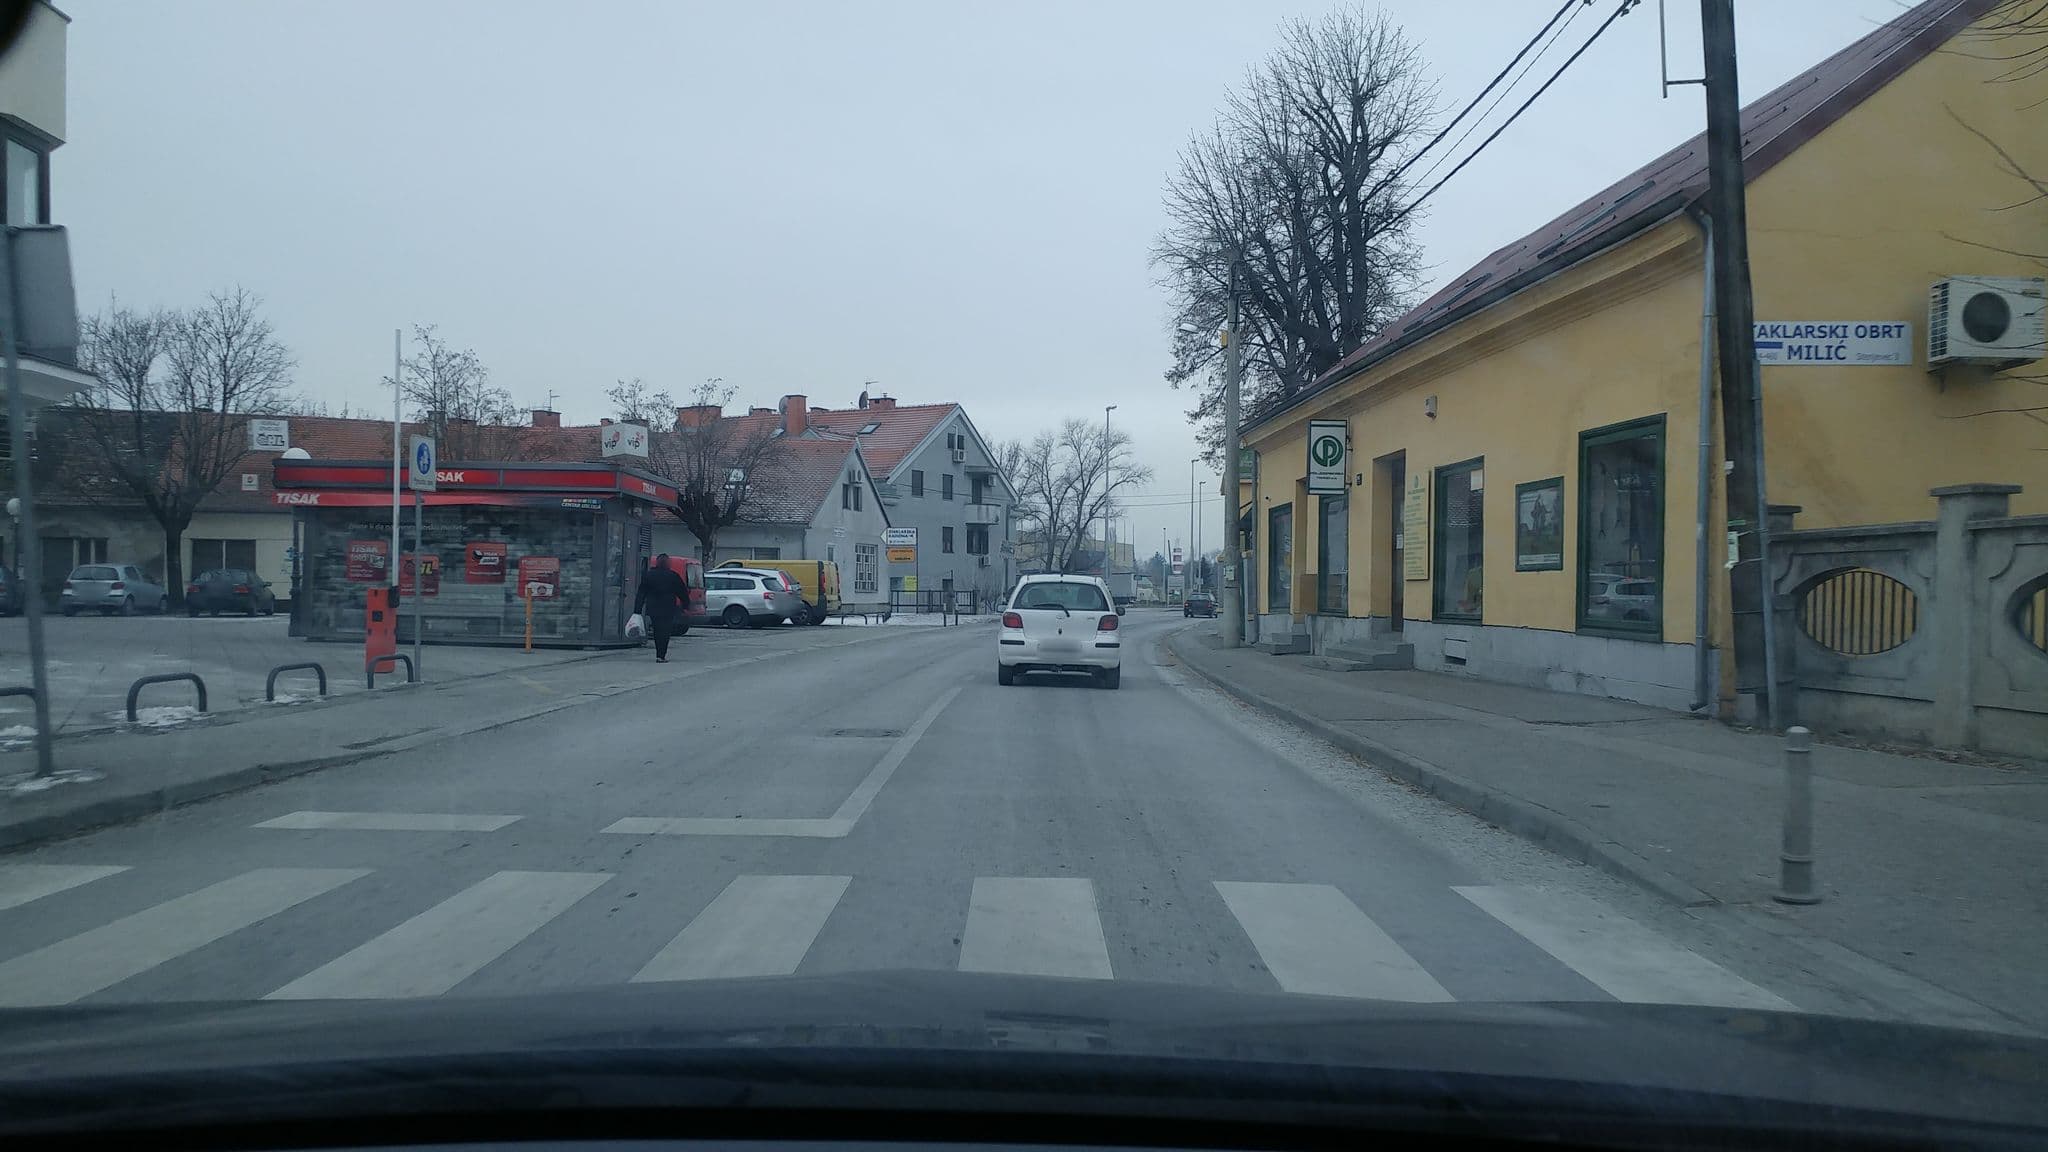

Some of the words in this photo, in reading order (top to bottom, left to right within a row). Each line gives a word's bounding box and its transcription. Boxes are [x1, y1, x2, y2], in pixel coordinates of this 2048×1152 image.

[1854, 325, 1905, 339] OBRT
[1787, 340, 1847, 361] MILIĆ
[604, 438, 617, 450] vip
[627, 437, 640, 450] vip
[642, 482, 657, 495] TISAK
[276, 493, 320, 505] TISAK
